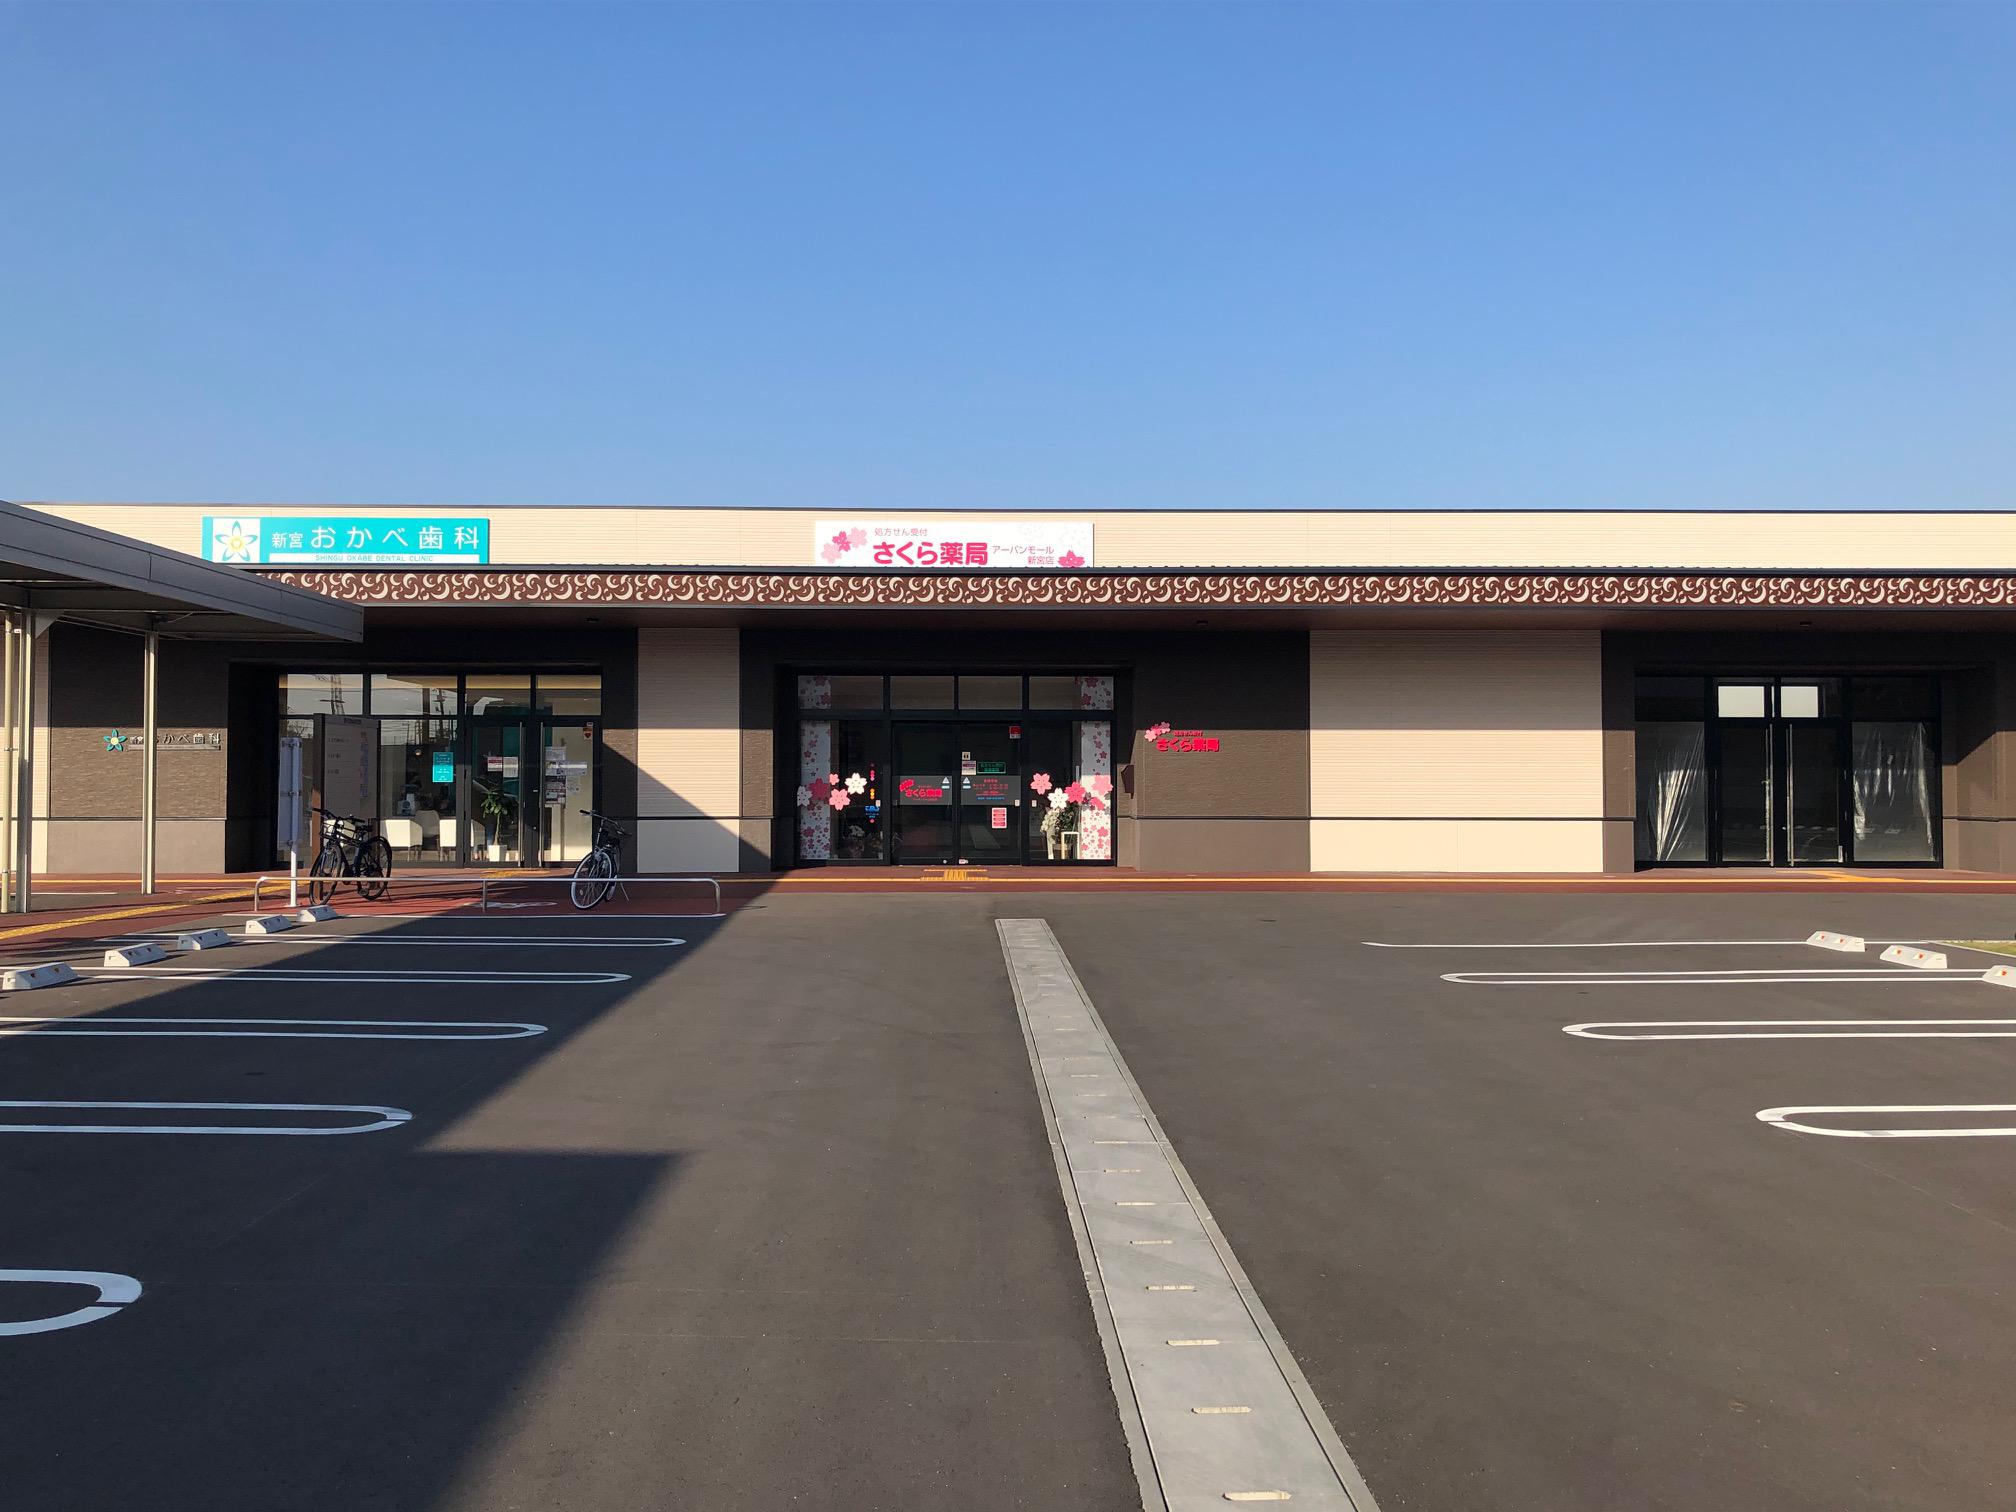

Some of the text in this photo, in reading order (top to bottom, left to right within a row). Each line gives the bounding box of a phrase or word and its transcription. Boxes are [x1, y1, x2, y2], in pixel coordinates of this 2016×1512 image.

[874, 527, 928, 537] 処方せん受付
[271, 525, 479, 551] 新宮 おかべ歯科
[873, 541, 988, 565] さくら薬局
[992, 544, 1055, 555] アーバンモール
[315, 554, 344, 562] SHINGU
[346, 554, 373, 562] OKABE
[1027, 555, 1054, 566] 新宮店
